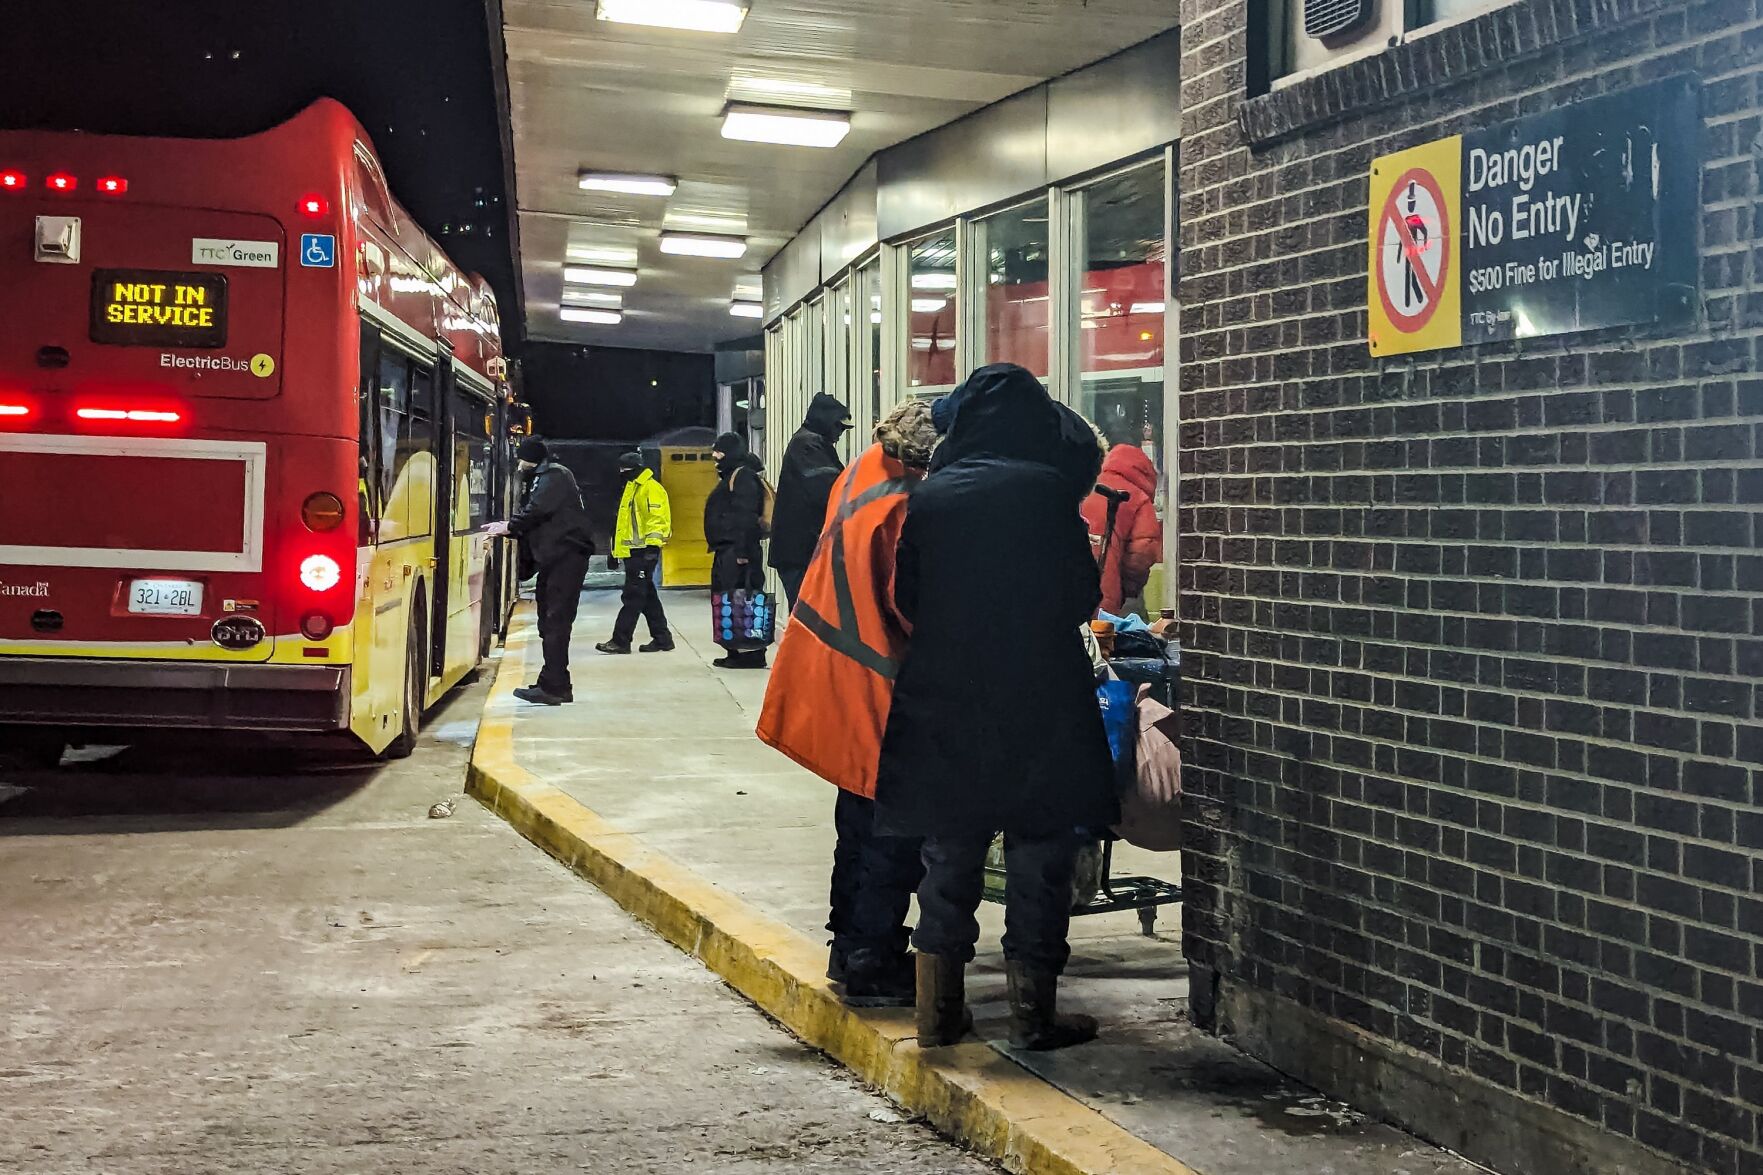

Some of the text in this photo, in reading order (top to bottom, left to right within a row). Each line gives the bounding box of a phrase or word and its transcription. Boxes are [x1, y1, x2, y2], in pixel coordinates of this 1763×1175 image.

[1469, 135, 1564, 192] Danger
[1469, 191, 1581, 249] No Entry
[200, 248, 272, 262] TTC Green
[1469, 240, 1655, 295] $500 Fine for Illegal Entry
[115, 283, 205, 305] NOT IN
[107, 304, 213, 327] SERVICE
[160, 353, 249, 371] ElectricBus
[0, 581, 49, 597] anada
[136, 588, 160, 605] 321
